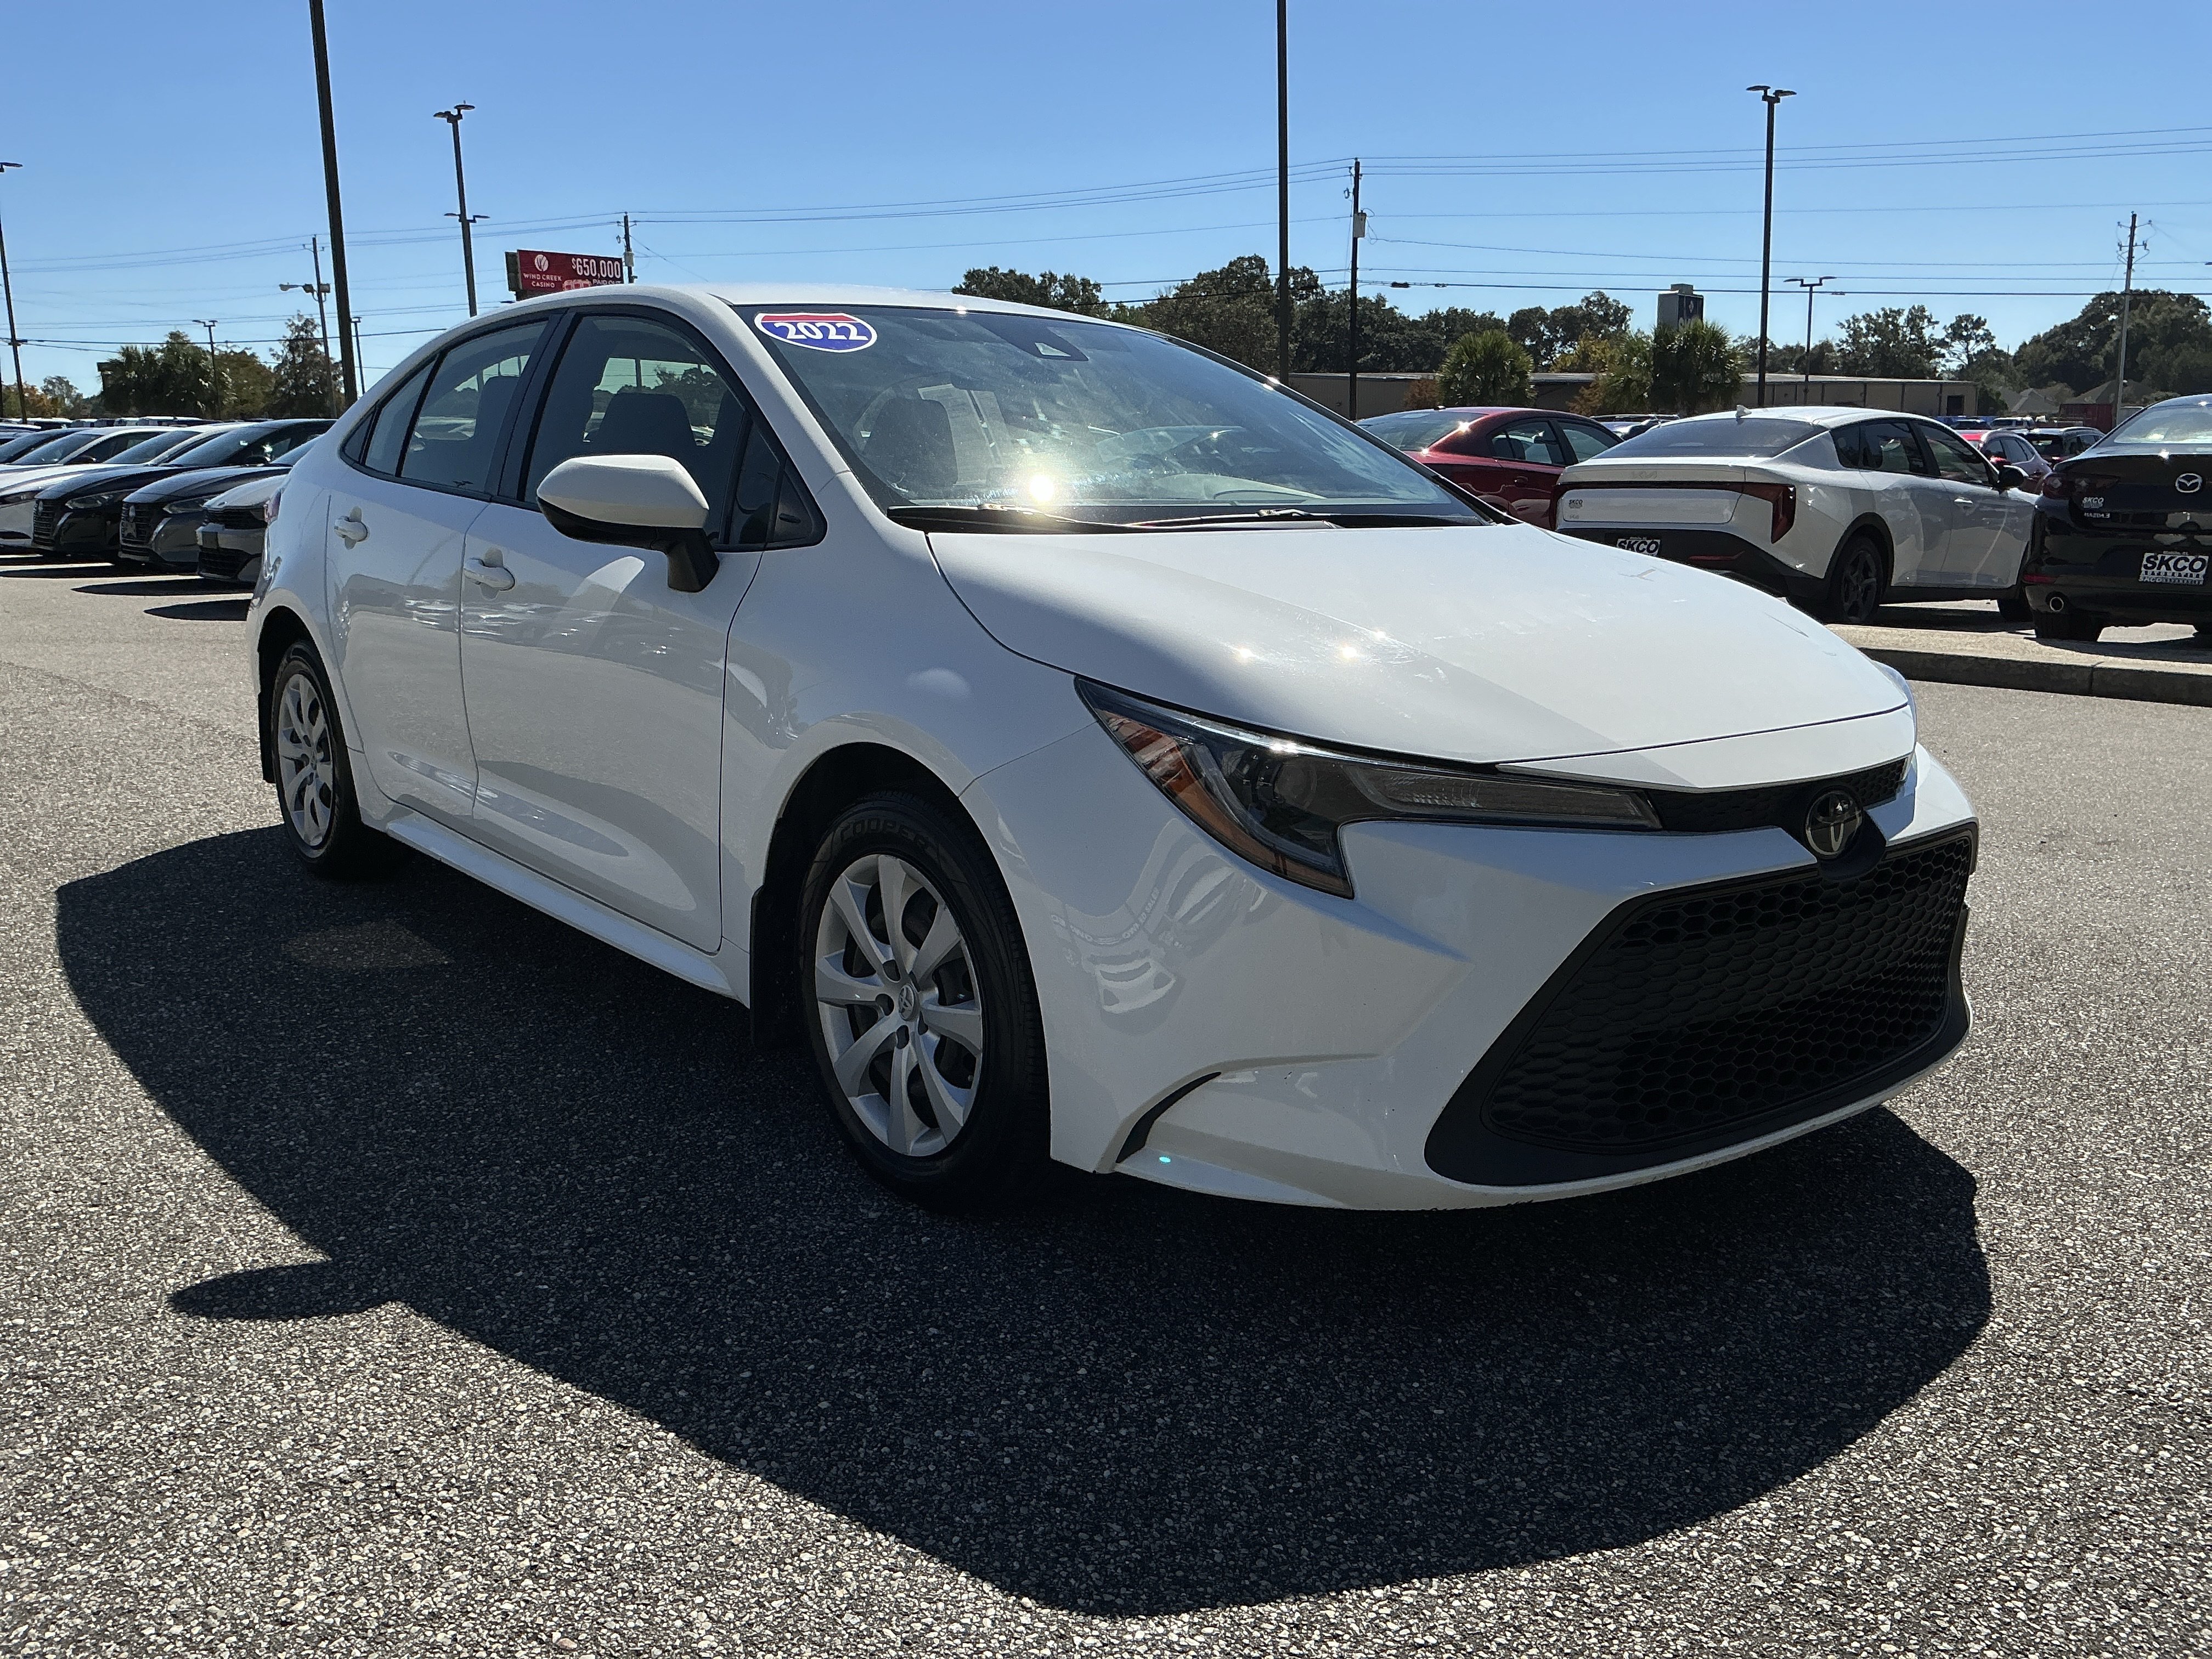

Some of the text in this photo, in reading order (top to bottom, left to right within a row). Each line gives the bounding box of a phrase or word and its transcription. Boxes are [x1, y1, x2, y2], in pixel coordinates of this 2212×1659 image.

[572, 257, 621, 278] $650,000
[774, 323, 869, 340] 2022
[1618, 540, 1659, 554] SKCO
[2143, 555, 2207, 573] SKCO
